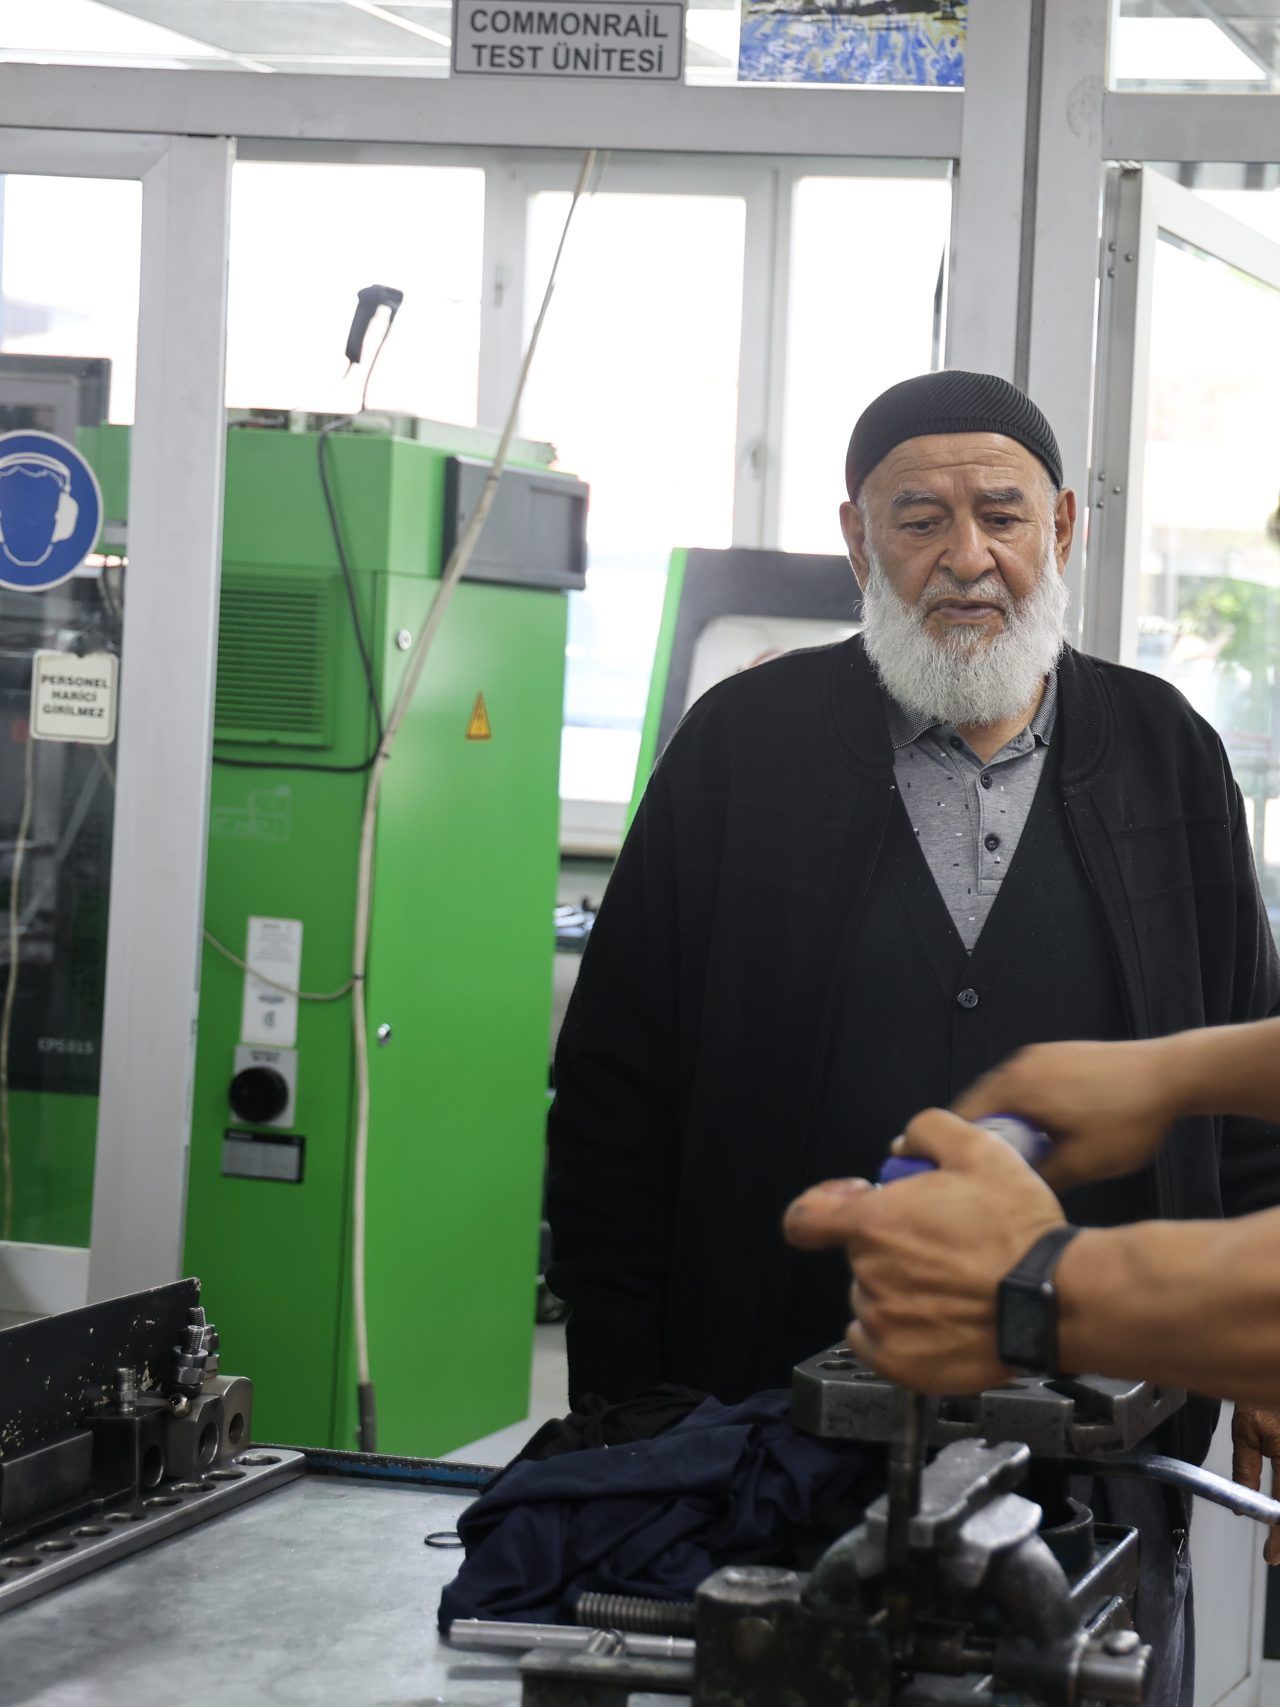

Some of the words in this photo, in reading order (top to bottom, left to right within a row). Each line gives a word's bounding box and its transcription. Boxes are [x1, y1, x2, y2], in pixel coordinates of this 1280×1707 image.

[469, 9, 668, 38] COMMONRAİL
[471, 43, 544, 69] TEST
[552, 42, 664, 73] ÜNİTESİ
[41, 674, 109, 689] PERSONEL
